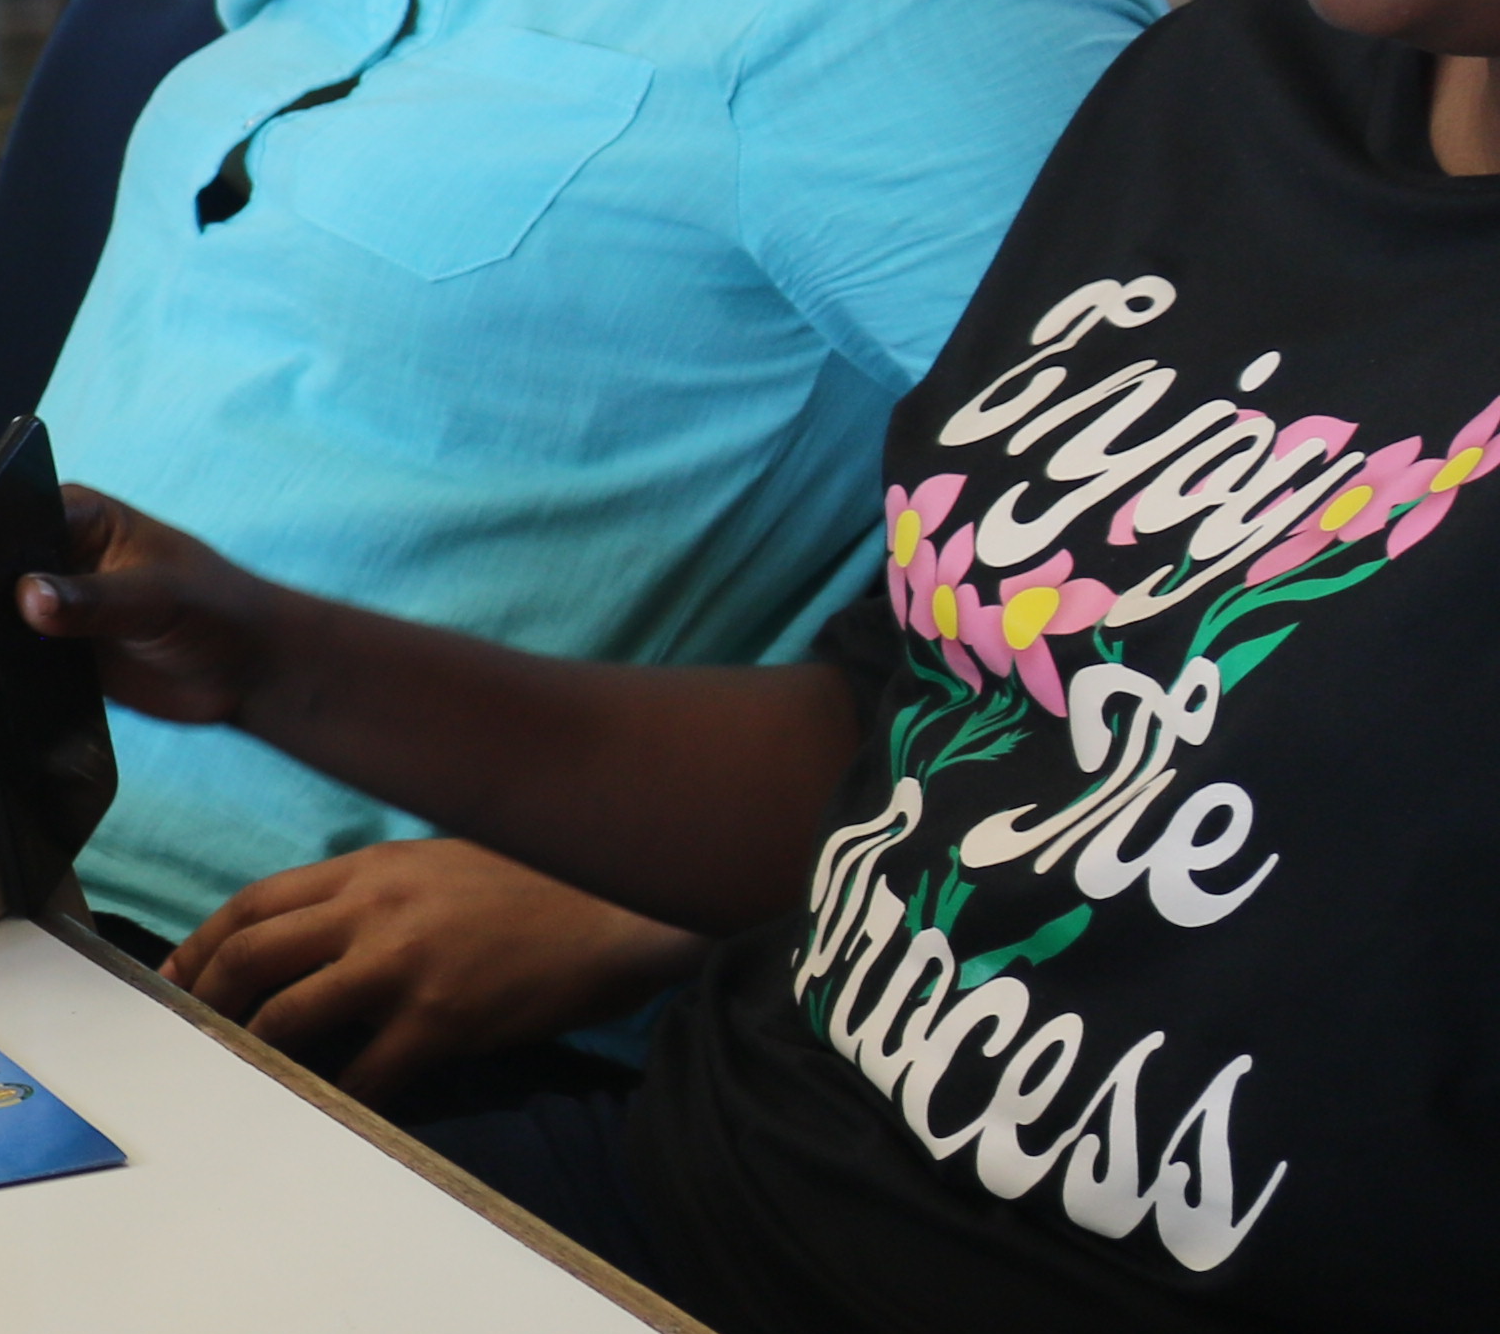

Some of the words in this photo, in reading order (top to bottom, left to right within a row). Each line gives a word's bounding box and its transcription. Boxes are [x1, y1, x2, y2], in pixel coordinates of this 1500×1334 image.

[939, 275, 1364, 627] Enjoy
[961, 656, 1278, 927] The
[793, 778, 1287, 1272] Process
